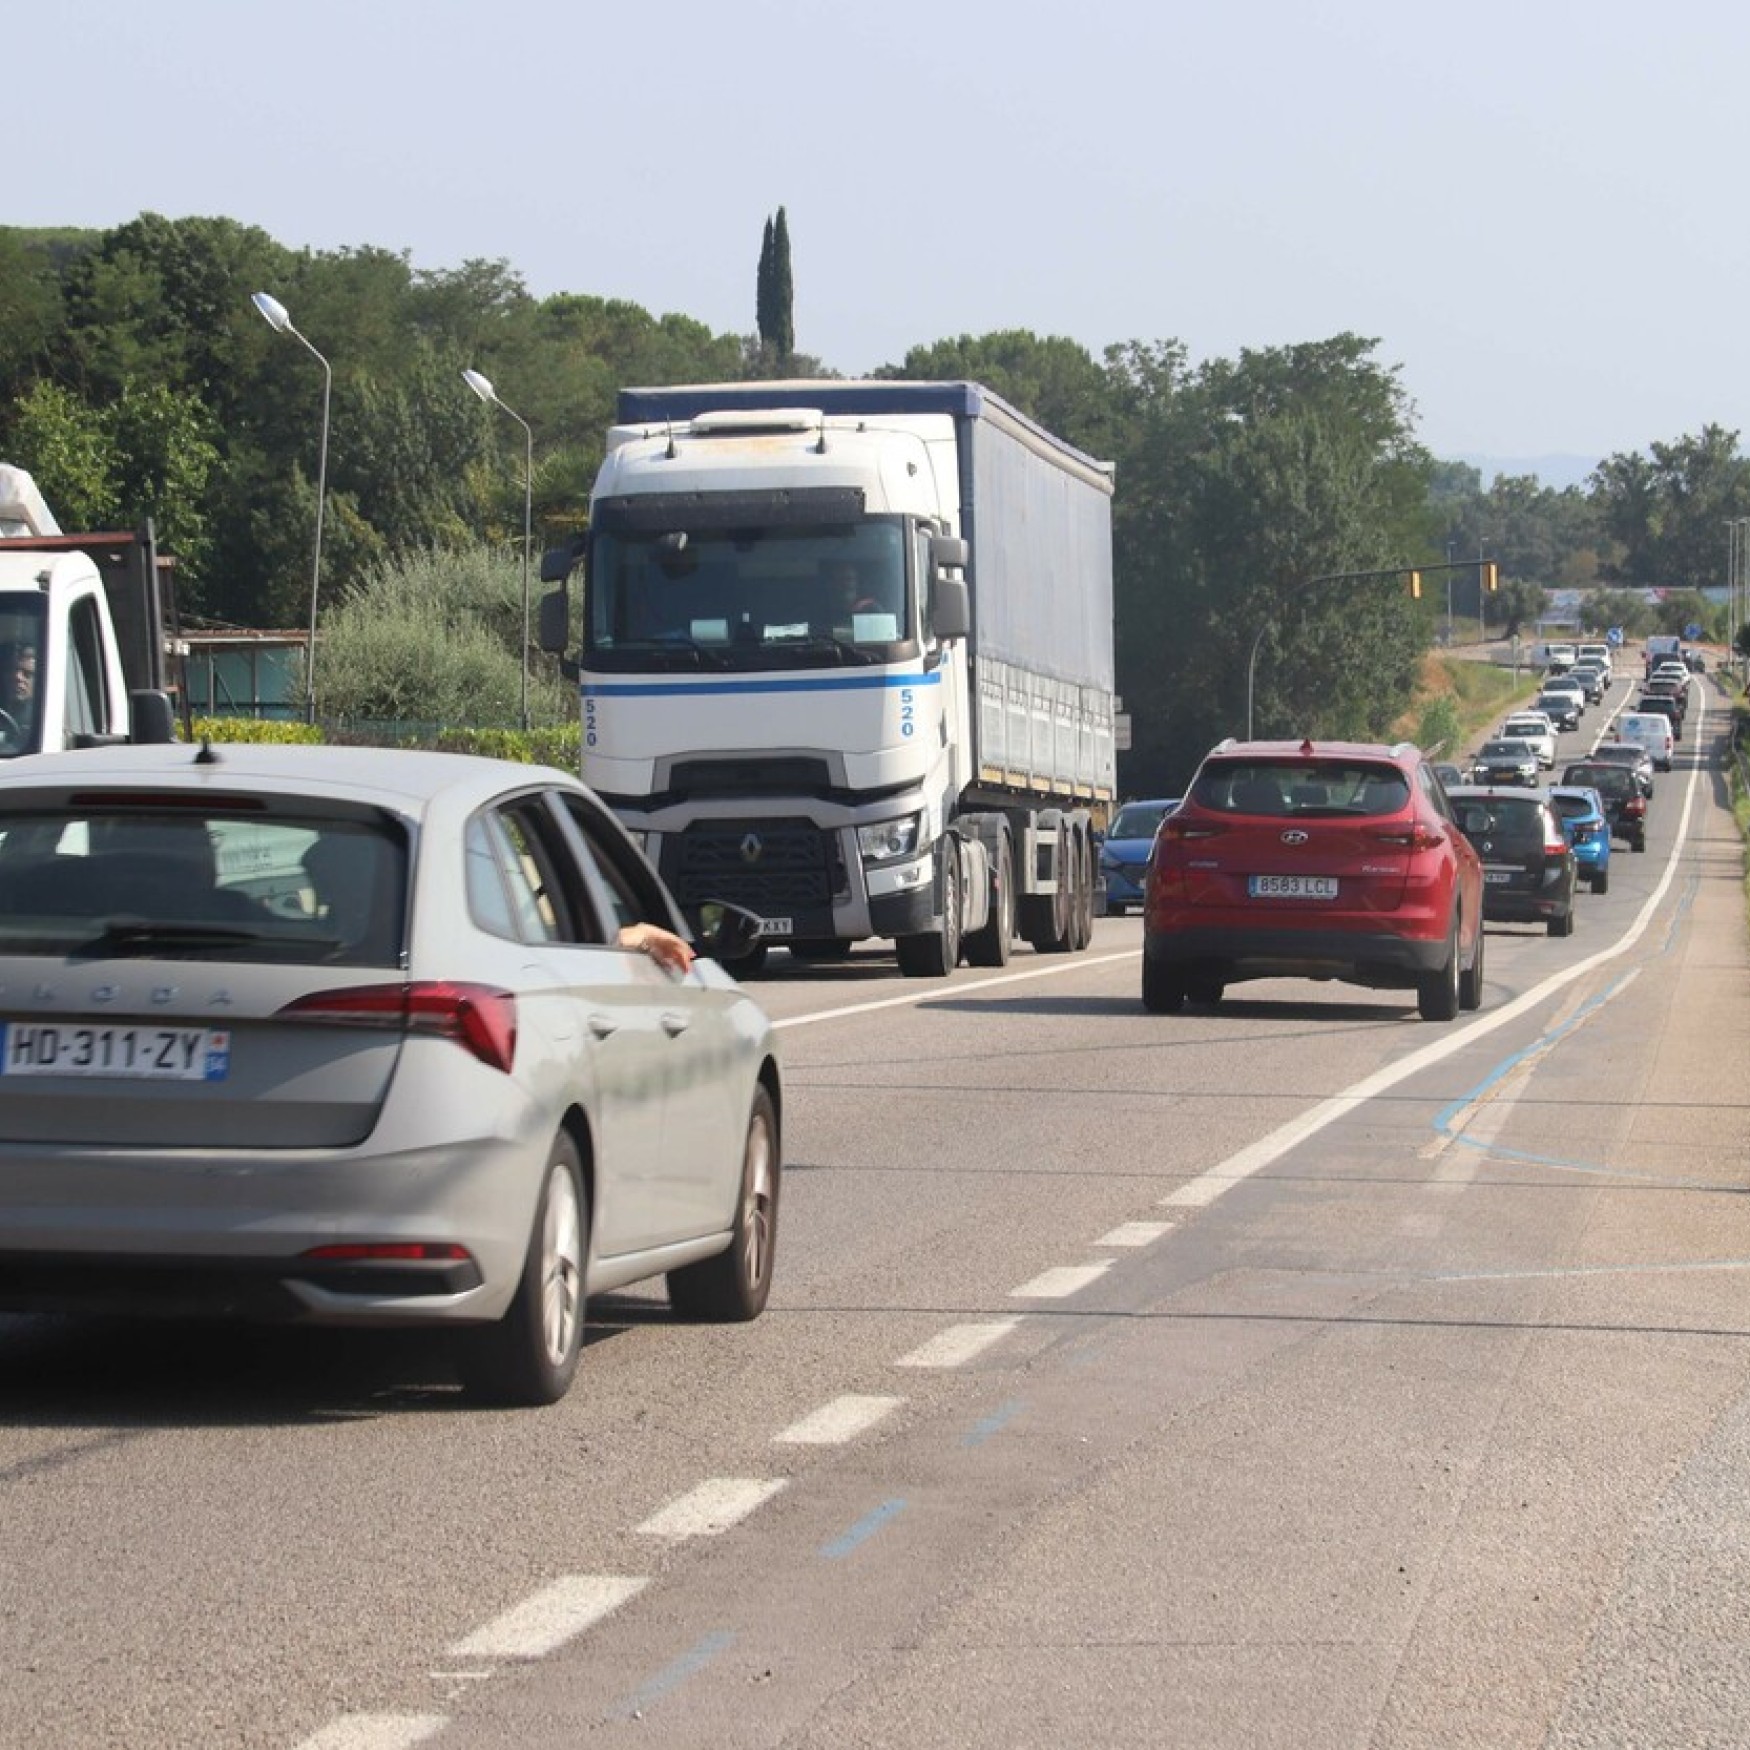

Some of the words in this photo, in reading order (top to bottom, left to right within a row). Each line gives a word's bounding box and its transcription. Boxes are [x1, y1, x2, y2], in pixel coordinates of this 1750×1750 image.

[586, 699, 597, 747] 520
[901, 688, 914, 736] 520
[1260, 877, 1300, 893] 8583
[1305, 879, 1334, 895] LCL
[13, 1028, 200, 1070] HD-311-ZY
